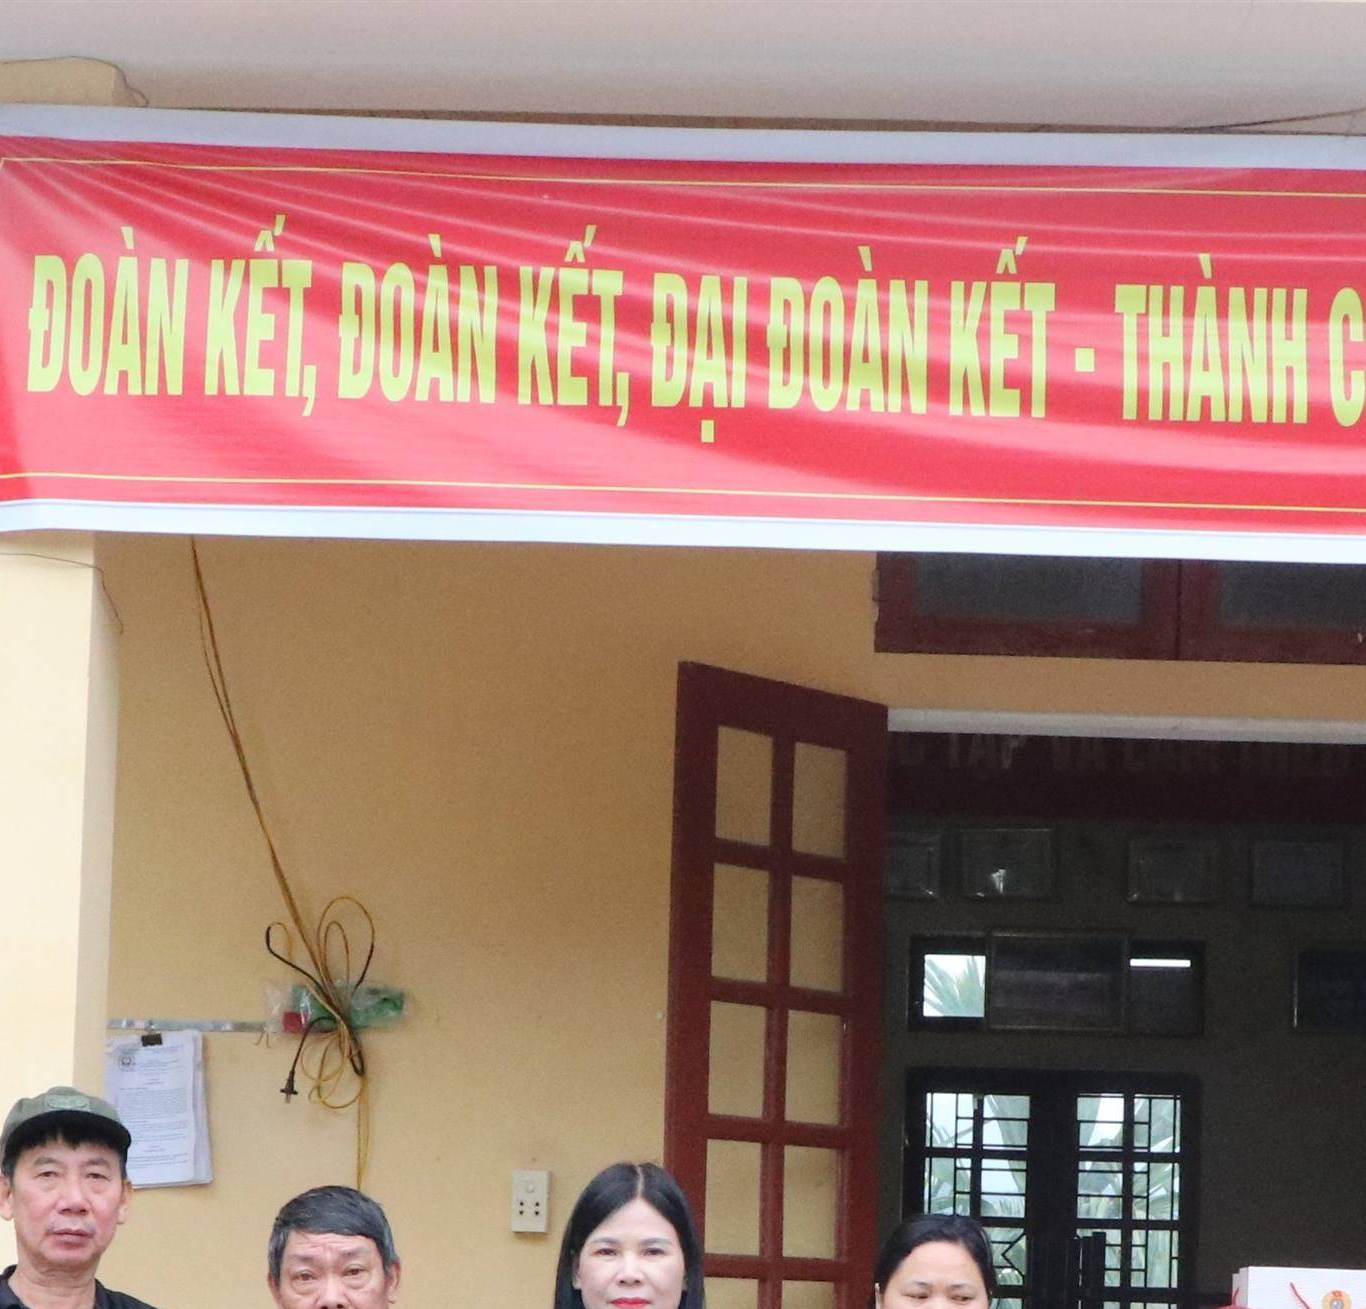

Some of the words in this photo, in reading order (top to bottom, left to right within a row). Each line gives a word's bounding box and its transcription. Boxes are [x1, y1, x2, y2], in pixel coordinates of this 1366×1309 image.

[27, 227, 189, 396] ĐOÀN
[205, 215, 317, 416] KẾT,
[338, 234, 497, 403] ĐOÀN
[517, 225, 630, 427] KẾT,
[650, 272, 748, 442] ĐẠI
[767, 246, 928, 415] ĐOÀN
[949, 236, 1056, 418] KẾT
[1075, 347, 1094, 372] -
[1114, 253, 1308, 423] THÀNH
